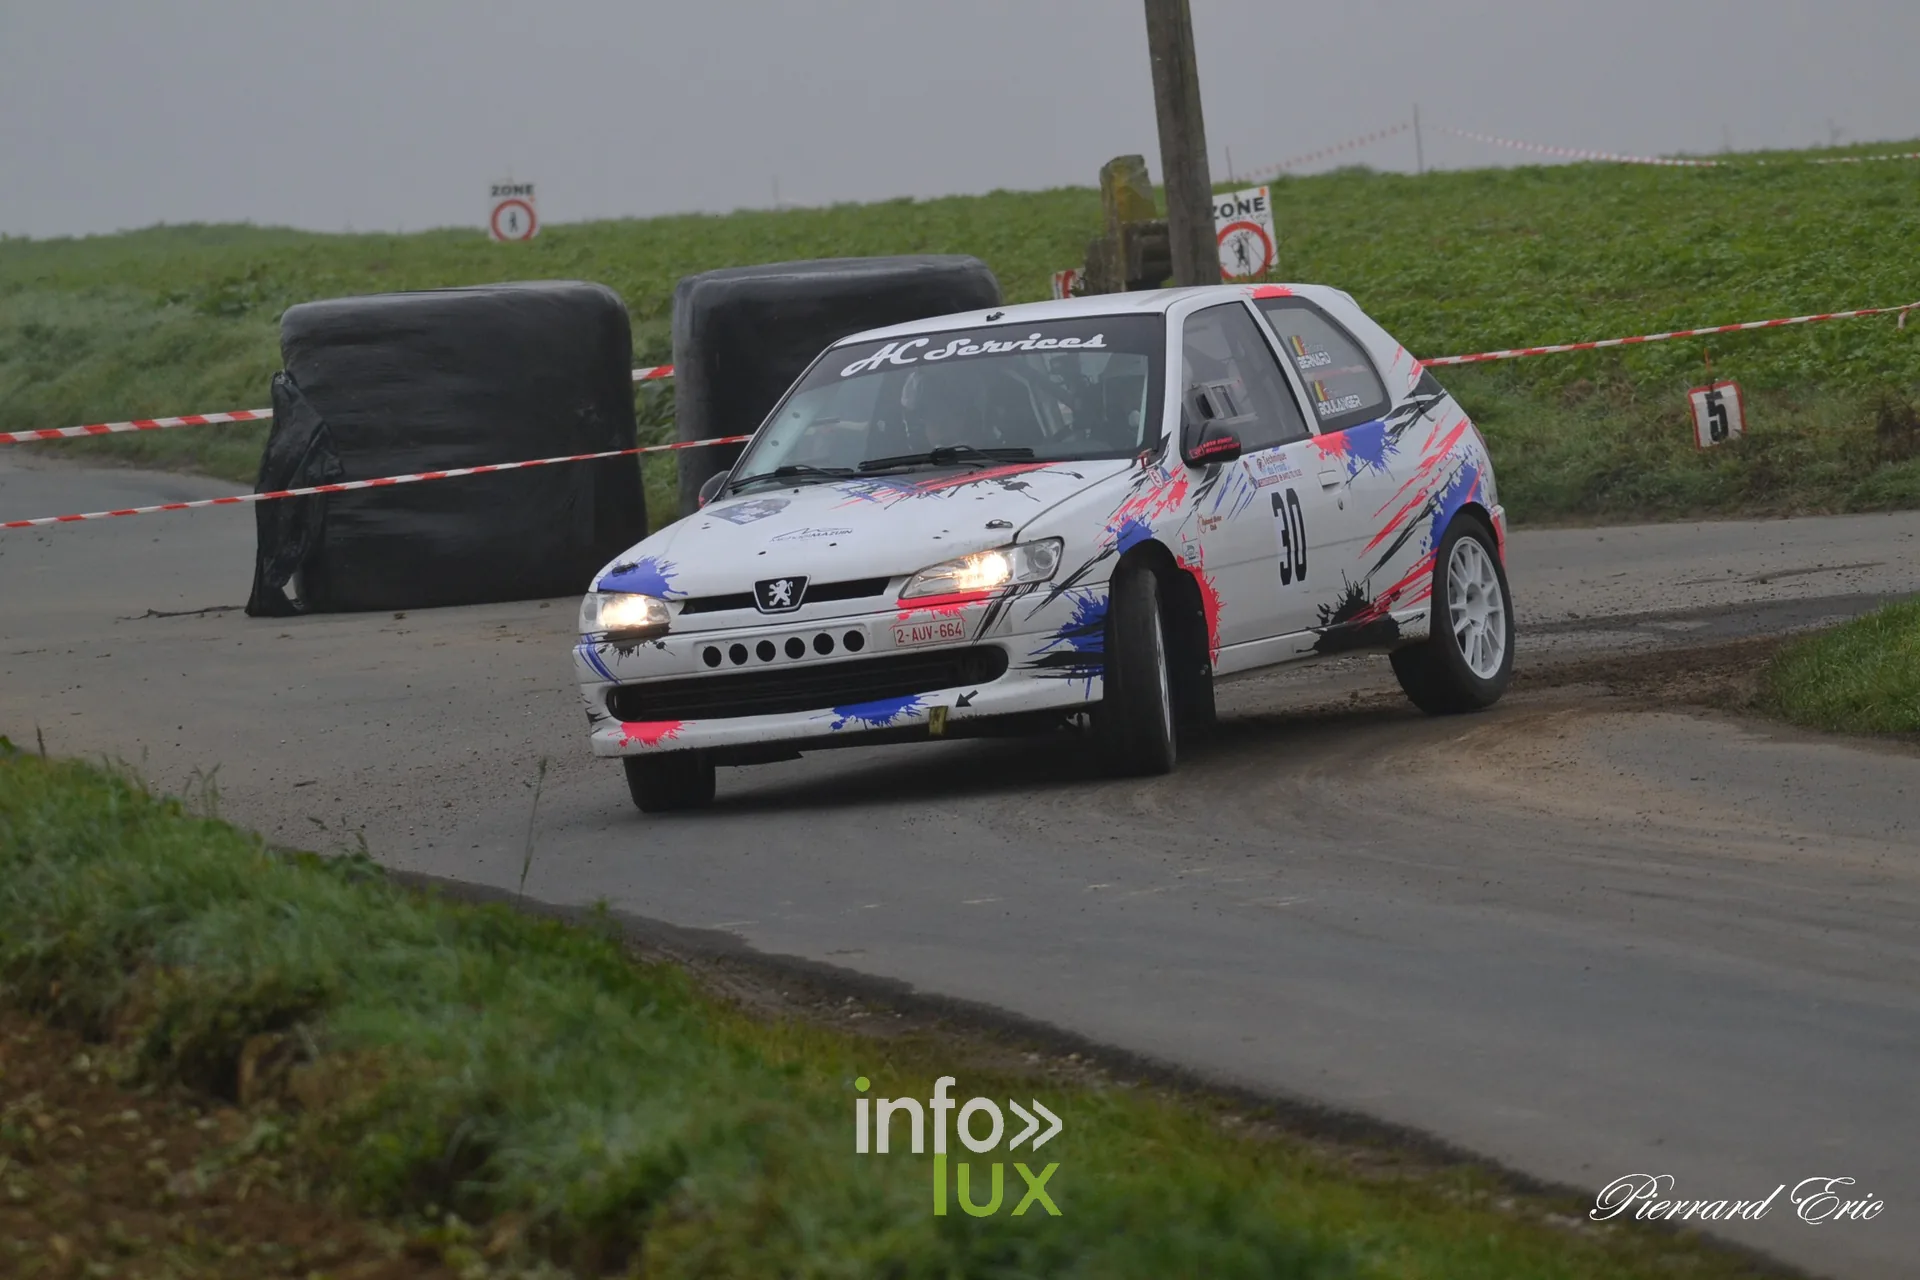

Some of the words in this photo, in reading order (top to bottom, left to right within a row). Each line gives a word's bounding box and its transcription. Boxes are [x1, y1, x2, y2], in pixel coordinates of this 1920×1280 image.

[491, 184, 534, 197] ZONE
[840, 338, 930, 377] AC
[923, 333, 1107, 361] Services
[1704, 391, 1729, 441] 5
[1271, 488, 1306, 586] 30
[896, 622, 962, 643] 2-AUV-664
